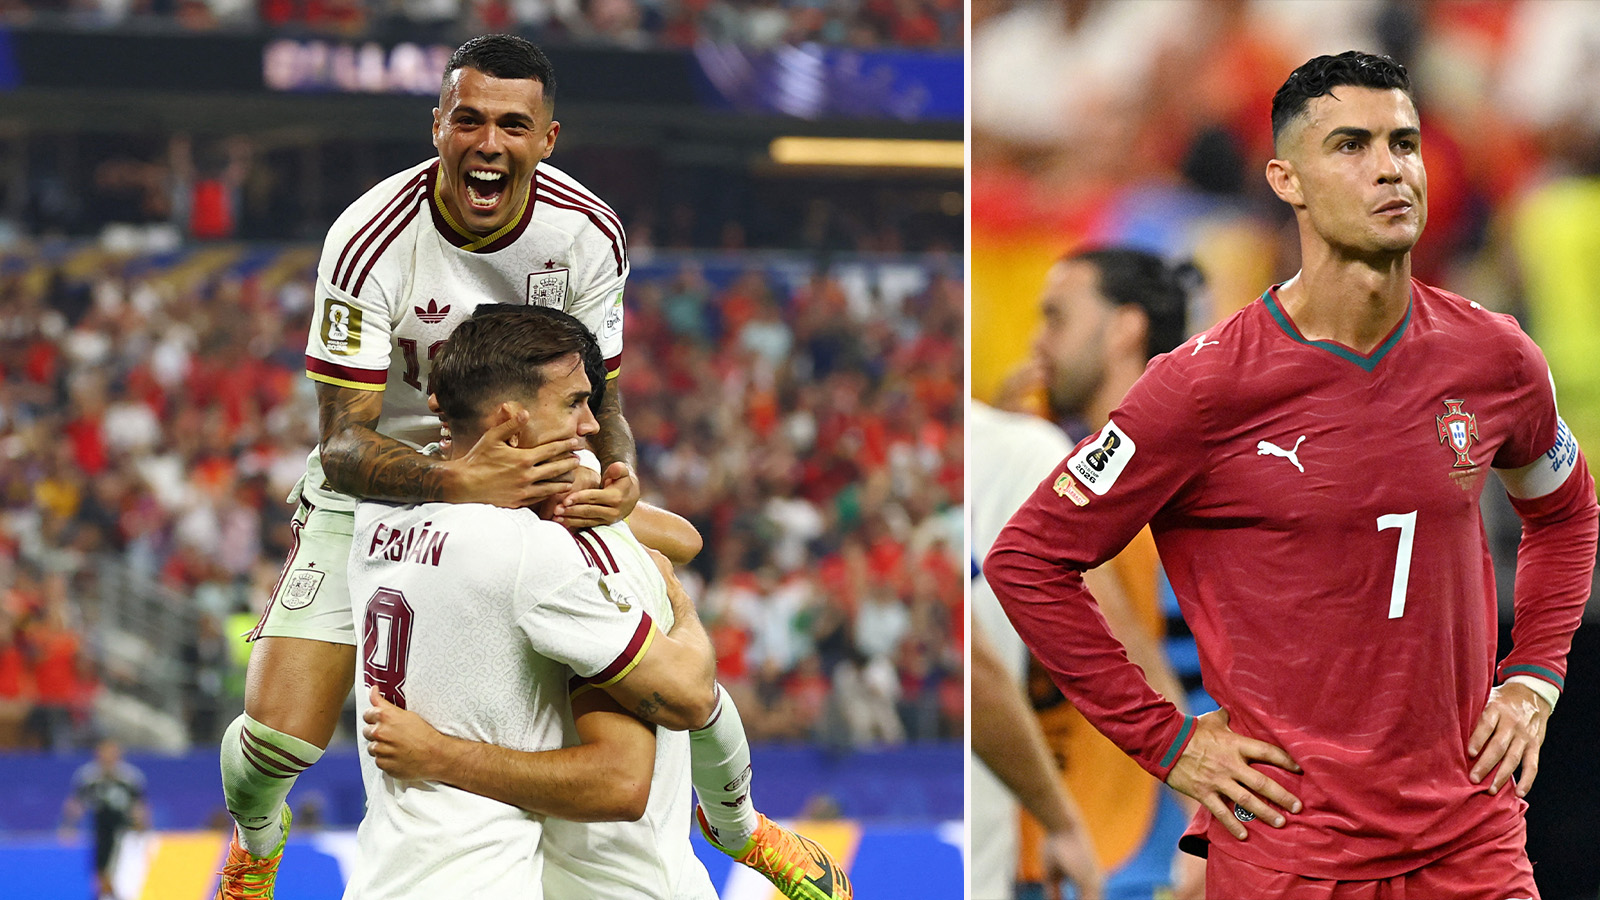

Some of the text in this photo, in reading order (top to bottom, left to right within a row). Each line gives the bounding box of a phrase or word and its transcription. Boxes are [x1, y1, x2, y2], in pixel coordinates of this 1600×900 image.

[397, 337, 449, 396] 1
[1075, 463, 1097, 484] 2026
[1376, 509, 1418, 619] 7
